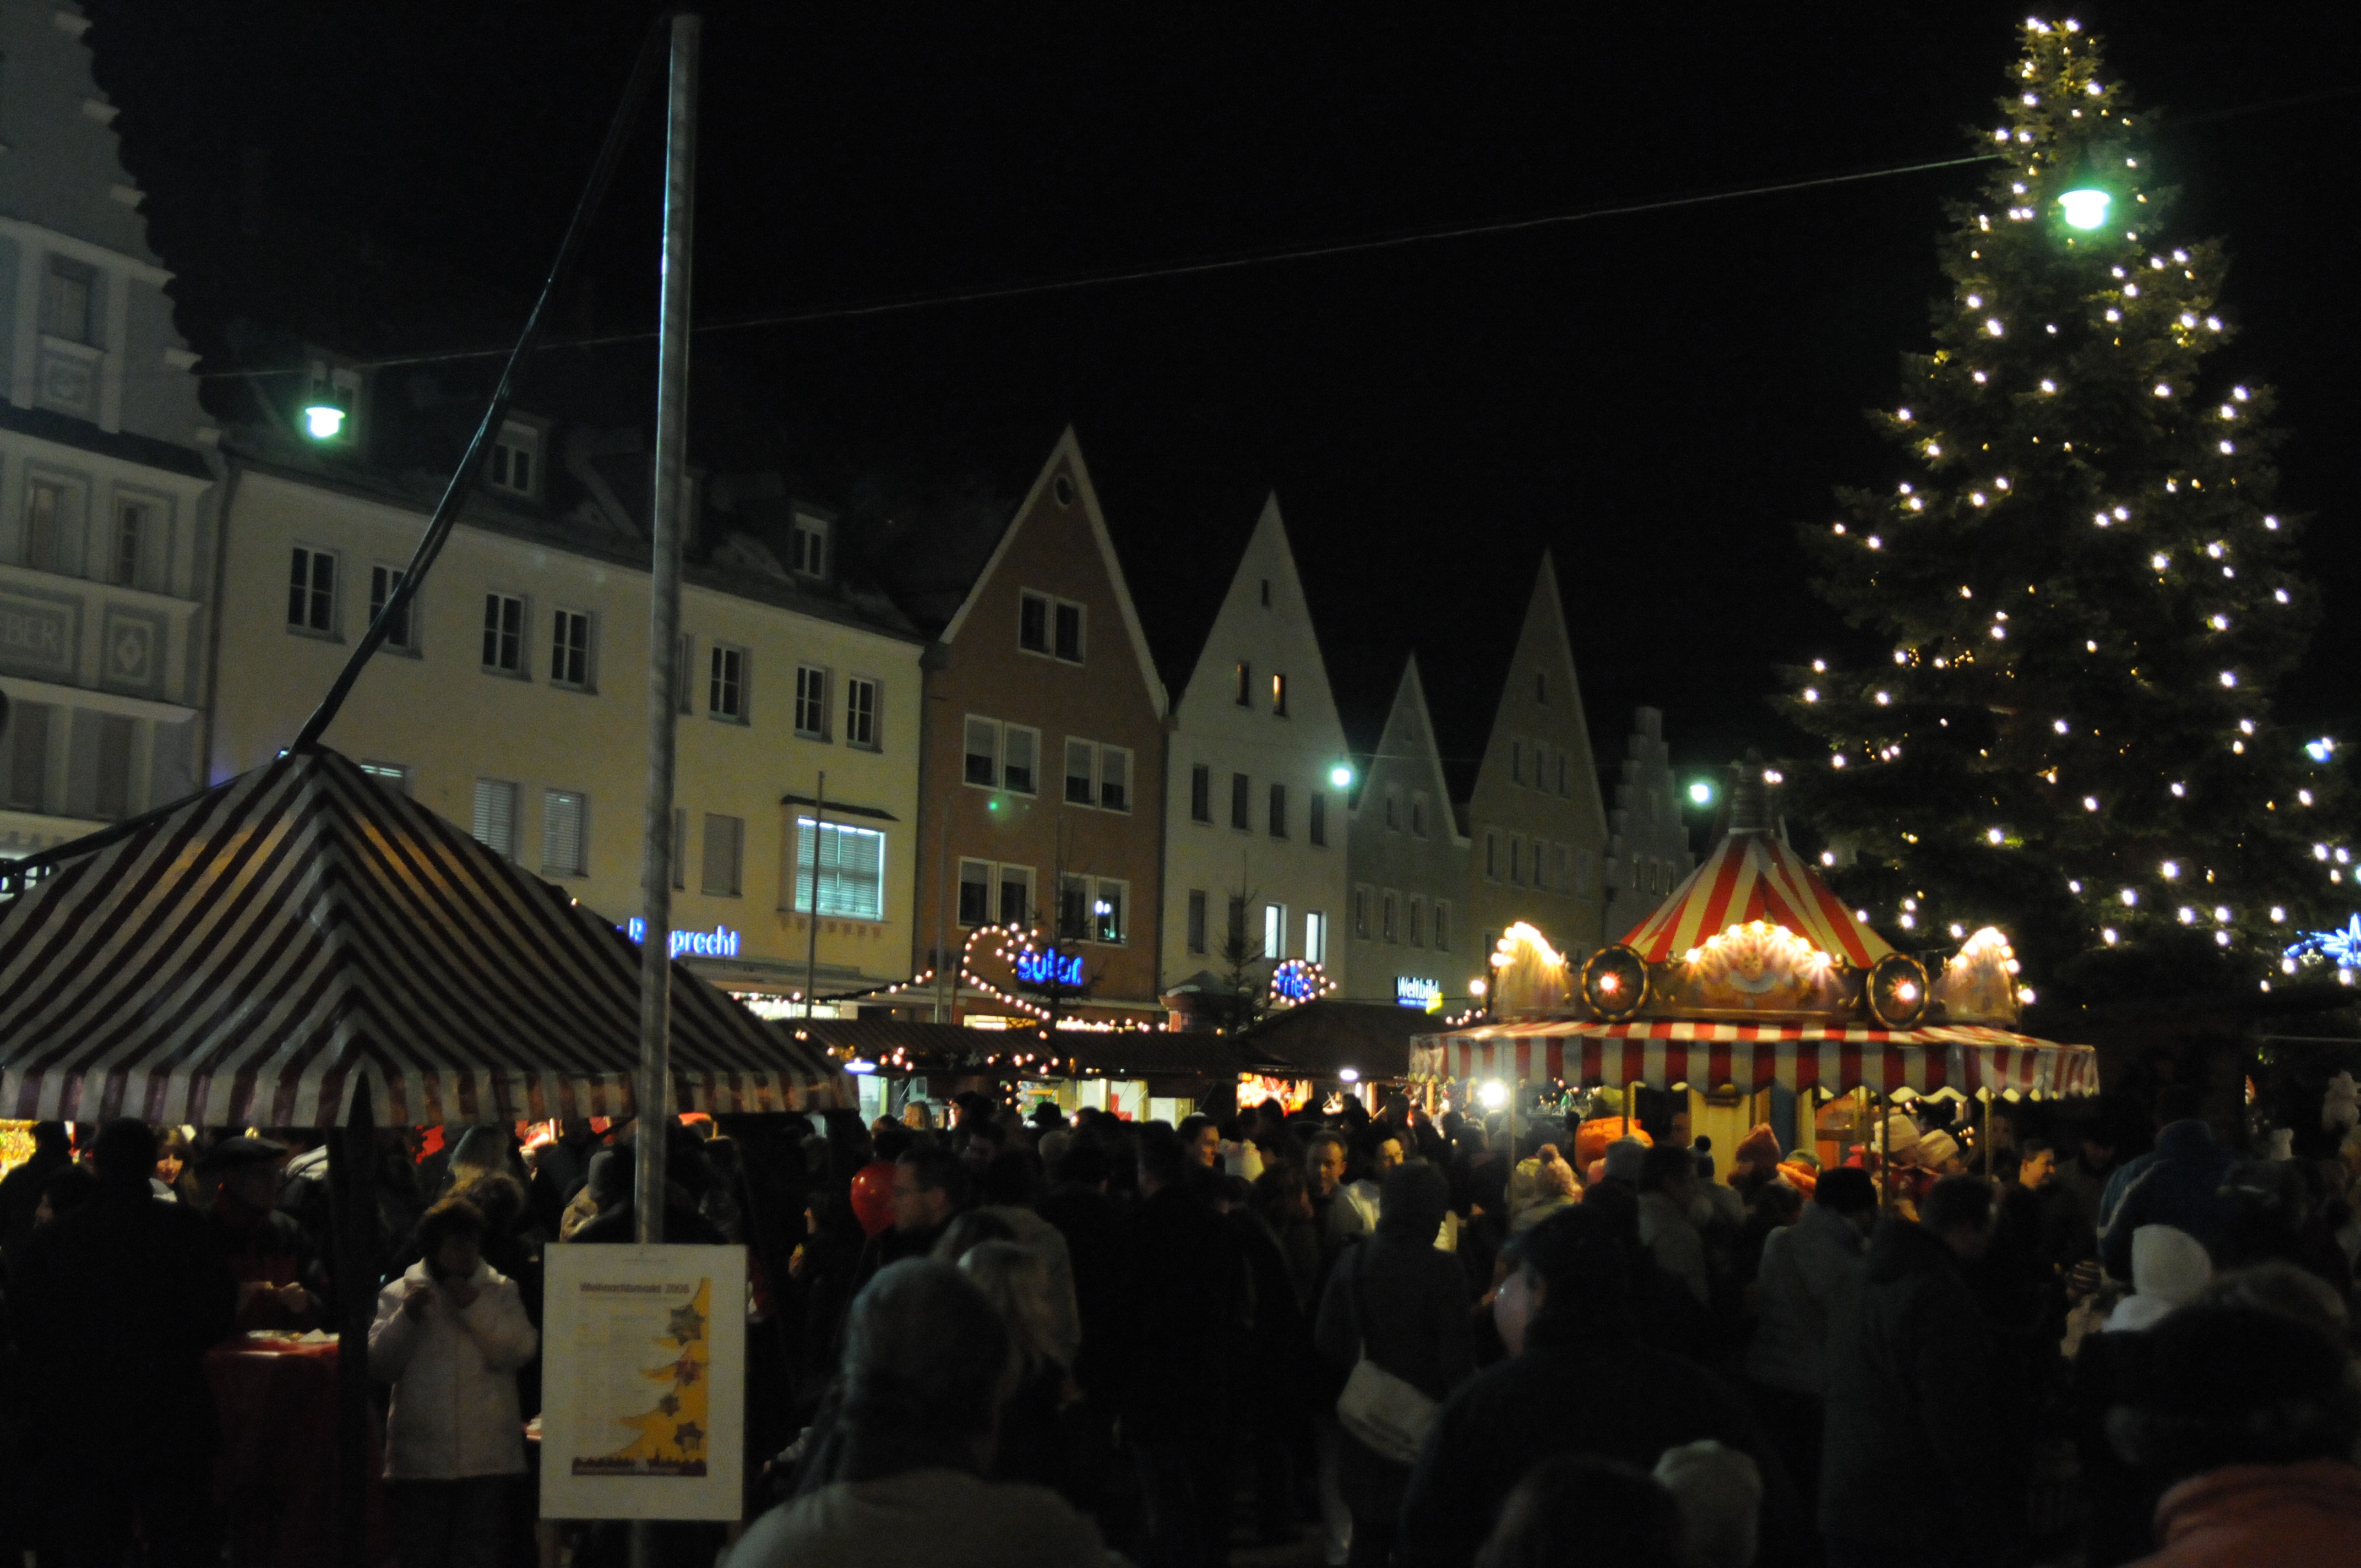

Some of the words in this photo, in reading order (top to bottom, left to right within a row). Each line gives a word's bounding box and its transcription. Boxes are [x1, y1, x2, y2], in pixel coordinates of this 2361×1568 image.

[0, 611, 58, 653] BER
[629, 917, 738, 959] Rprecht
[1397, 976, 1440, 999] Weltbild
